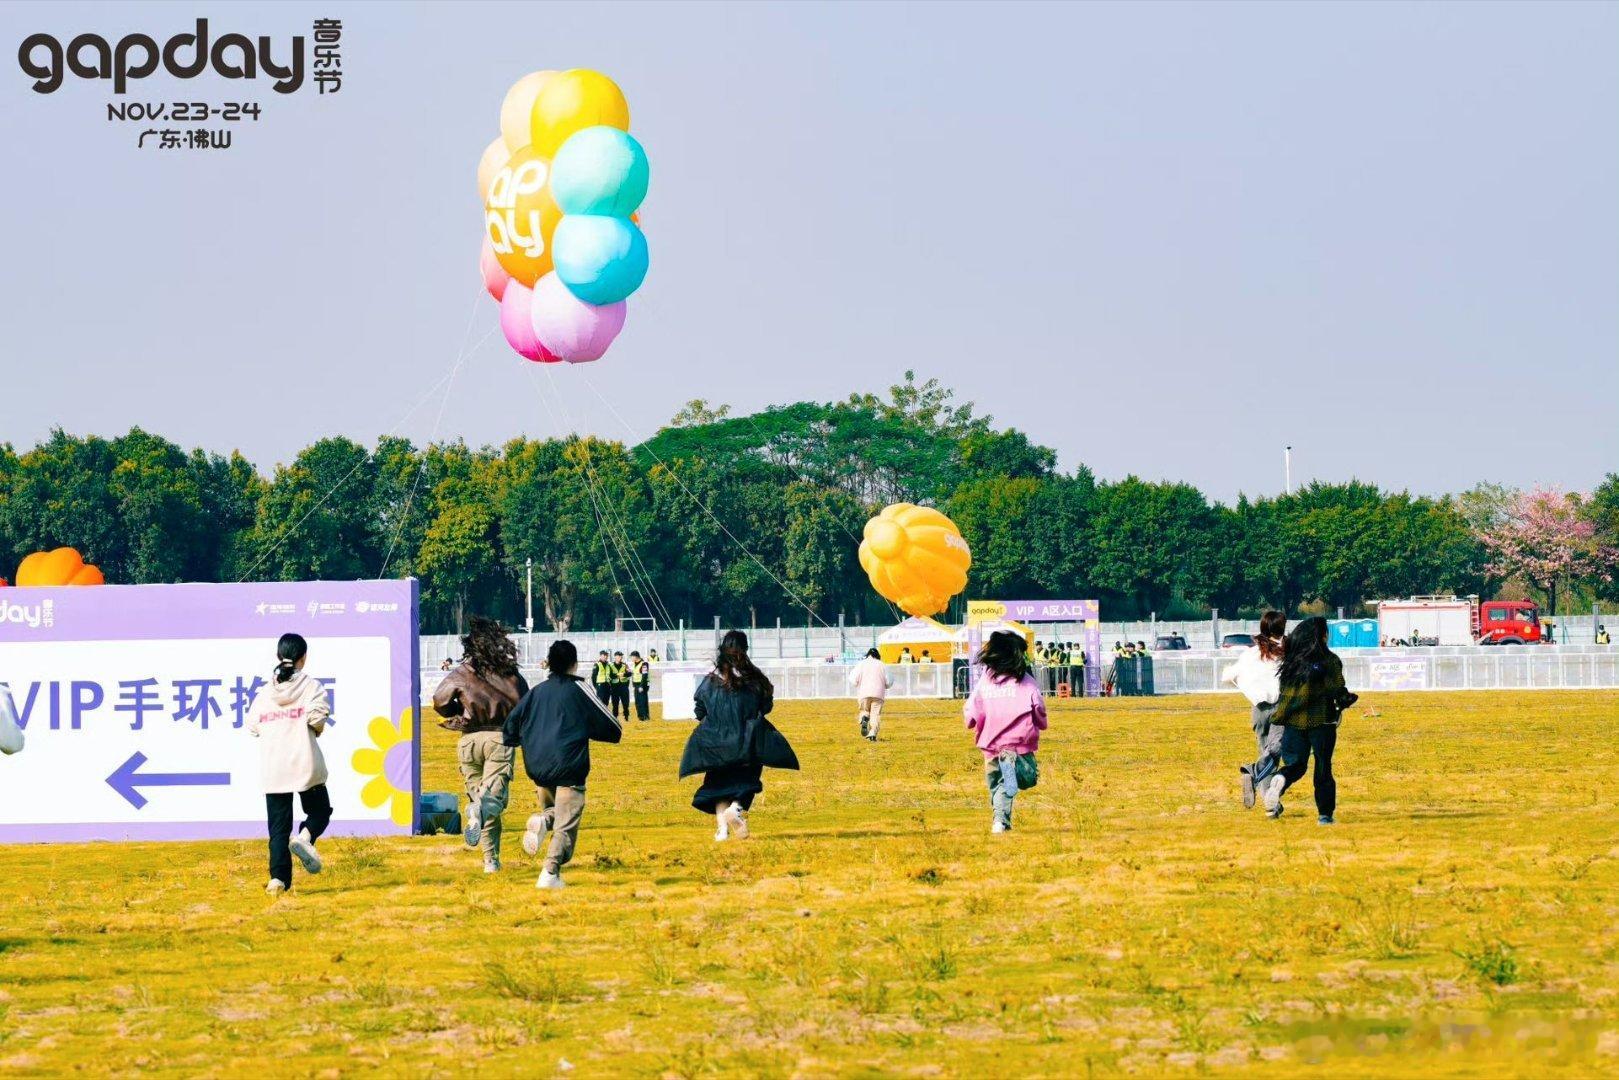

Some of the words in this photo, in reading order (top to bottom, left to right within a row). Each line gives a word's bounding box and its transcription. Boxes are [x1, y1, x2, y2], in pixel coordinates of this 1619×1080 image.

[485, 208, 545, 257] ay
[1016, 605, 1035, 616] VIP
[1042, 605, 1083, 616] A区入口
